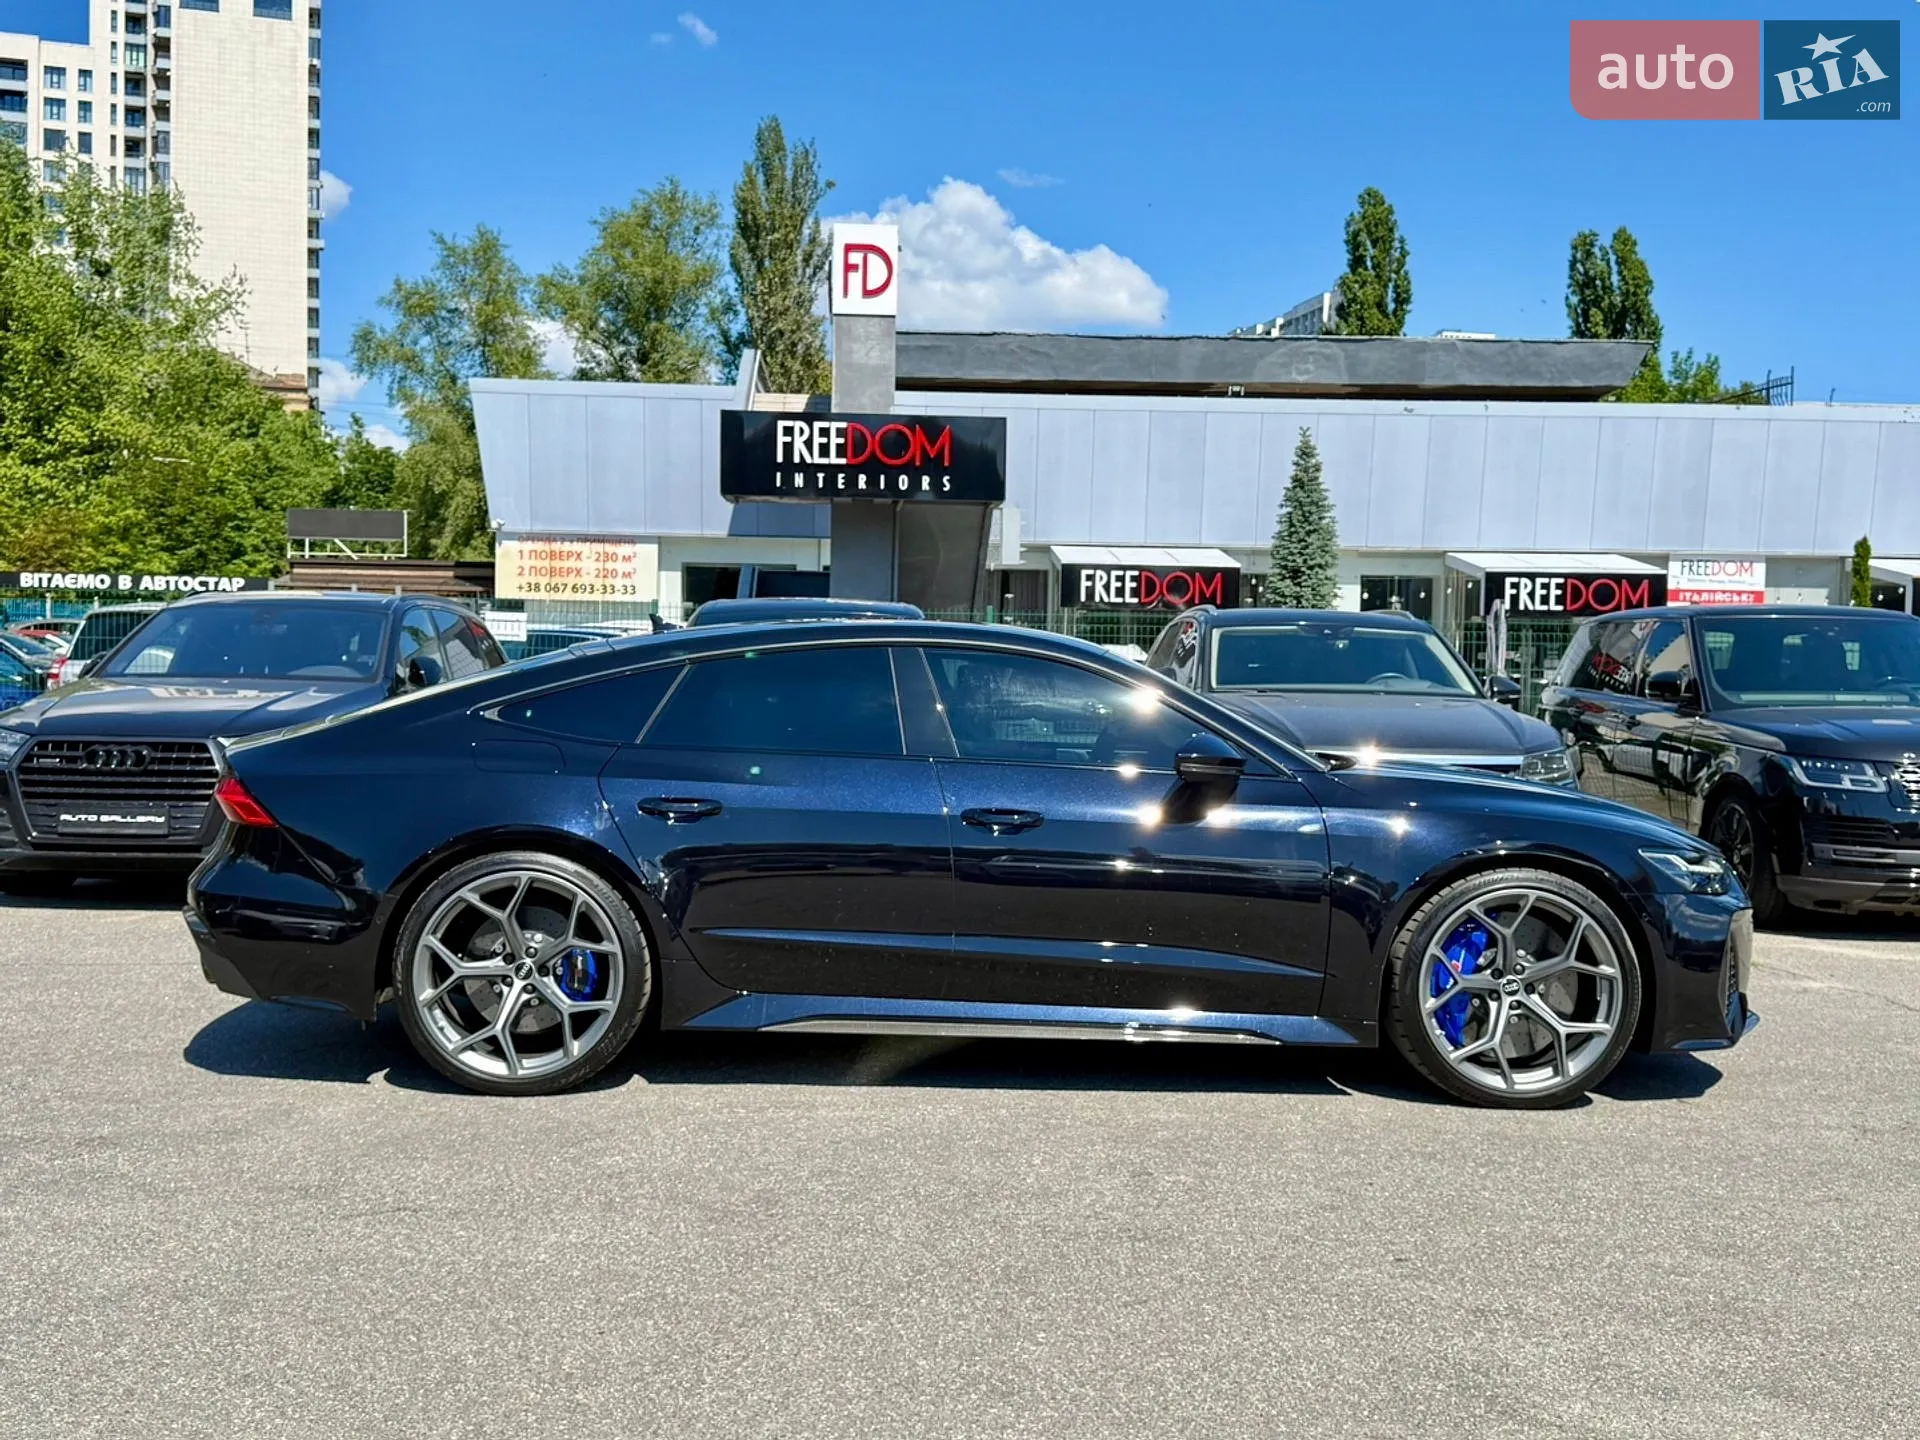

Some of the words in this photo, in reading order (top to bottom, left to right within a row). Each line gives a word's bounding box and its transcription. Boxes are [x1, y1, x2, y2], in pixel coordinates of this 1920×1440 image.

[842, 243, 894, 299] FD
[776, 420, 954, 468] FREEDOM
[775, 472, 952, 492] INTERIORS
[518, 549, 524, 561] 1
[528, 550, 584, 562] ПОВЕРХ
[517, 565, 525, 577] 2
[528, 566, 584, 578] ПОВЕРХ
[595, 567, 619, 579] 220
[1681, 559, 1754, 577] FREEDOM
[19, 572, 111, 590] ВІТАЄМО
[118, 574, 133, 591] В
[139, 576, 246, 592] АВТОСТАР
[516, 582, 542, 594] +38
[544, 583, 569, 595] 067
[571, 583, 638, 596] 693-33-33
[1079, 569, 1224, 606] FREEDOM
[1504, 577, 1650, 611] FREEDOM
[59, 814, 98, 823] AUTO
[100, 815, 166, 824] GALLERY
